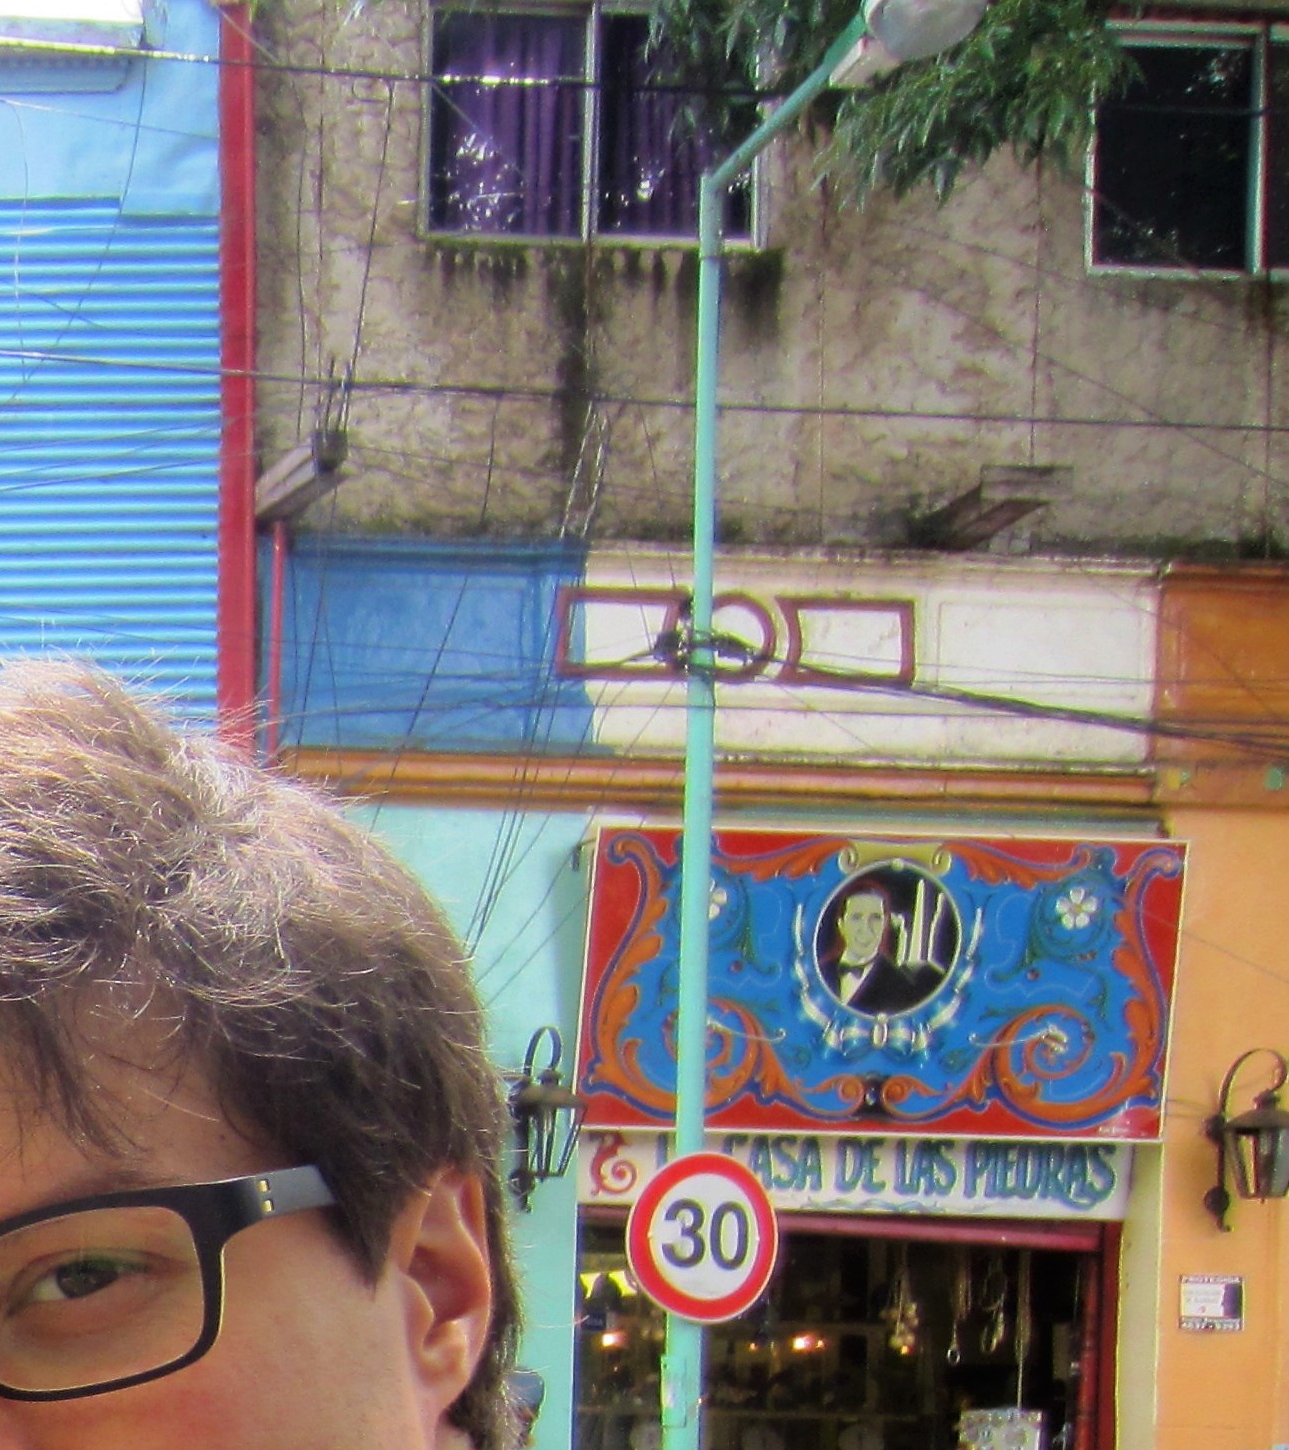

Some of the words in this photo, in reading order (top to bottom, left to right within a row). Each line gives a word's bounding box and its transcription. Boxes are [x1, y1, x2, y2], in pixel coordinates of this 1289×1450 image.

[833, 1137, 888, 1194] DE
[893, 1137, 959, 1196] LAS
[963, 1139, 1118, 1211] PIEDRAS
[661, 1197, 749, 1271] 30
